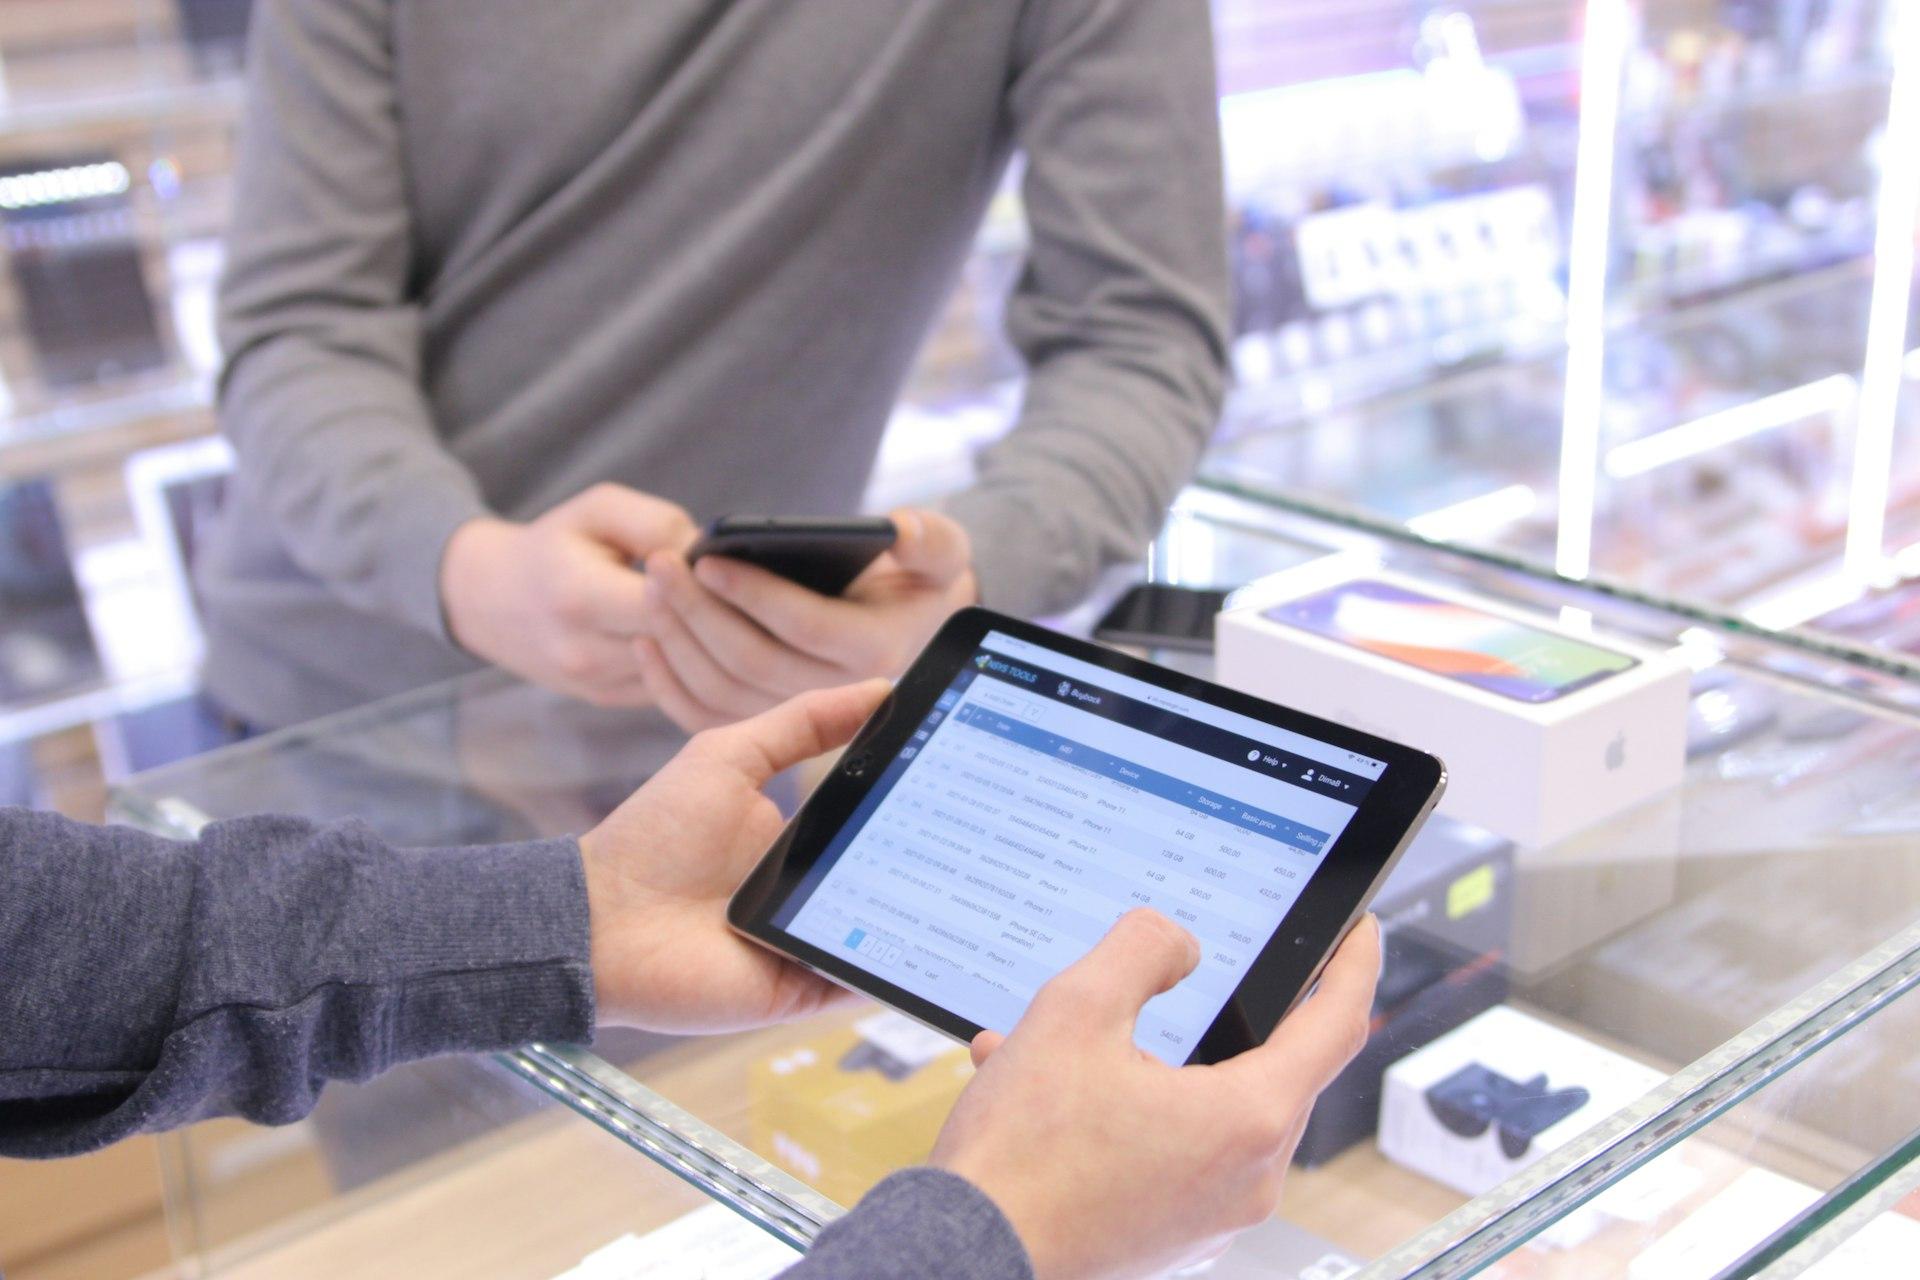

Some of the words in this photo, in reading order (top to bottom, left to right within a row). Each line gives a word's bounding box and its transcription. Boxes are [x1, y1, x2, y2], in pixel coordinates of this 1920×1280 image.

[1009, 667, 1037, 682] TOOLS
[1070, 689, 1101, 705] Buyback
[1262, 755, 1279, 767] Help
[1318, 775, 1341, 787] DimaB
[1119, 767, 1140, 779] Device
[1197, 796, 1223, 810] Storage
[1241, 812, 1260, 823] Basic
[1259, 819, 1277, 830] price
[1295, 832, 1319, 846] Selling
[1097, 799, 1117, 810] iPhone
[1184, 832, 1195, 840] GB
[1067, 839, 1088, 851] iPhone
[1082, 819, 1103, 831] iPhone
[1161, 850, 1173, 858] 128
[1038, 880, 1059, 891] iPhone
[1053, 859, 1073, 871] iPhone
[1131, 891, 1140, 899] 64
[1022, 900, 1044, 913] iPhone
[999, 931, 1035, 950] generation)
[1008, 921, 1029, 934] iPhone
[1028, 929, 1038, 937] SE
[1036, 933, 1053, 944] (2nd
[985, 952, 1007, 964] iPhone
[1006, 960, 1015, 968] 11
[903, 960, 919, 970] Next
[924, 970, 939, 980] Last
